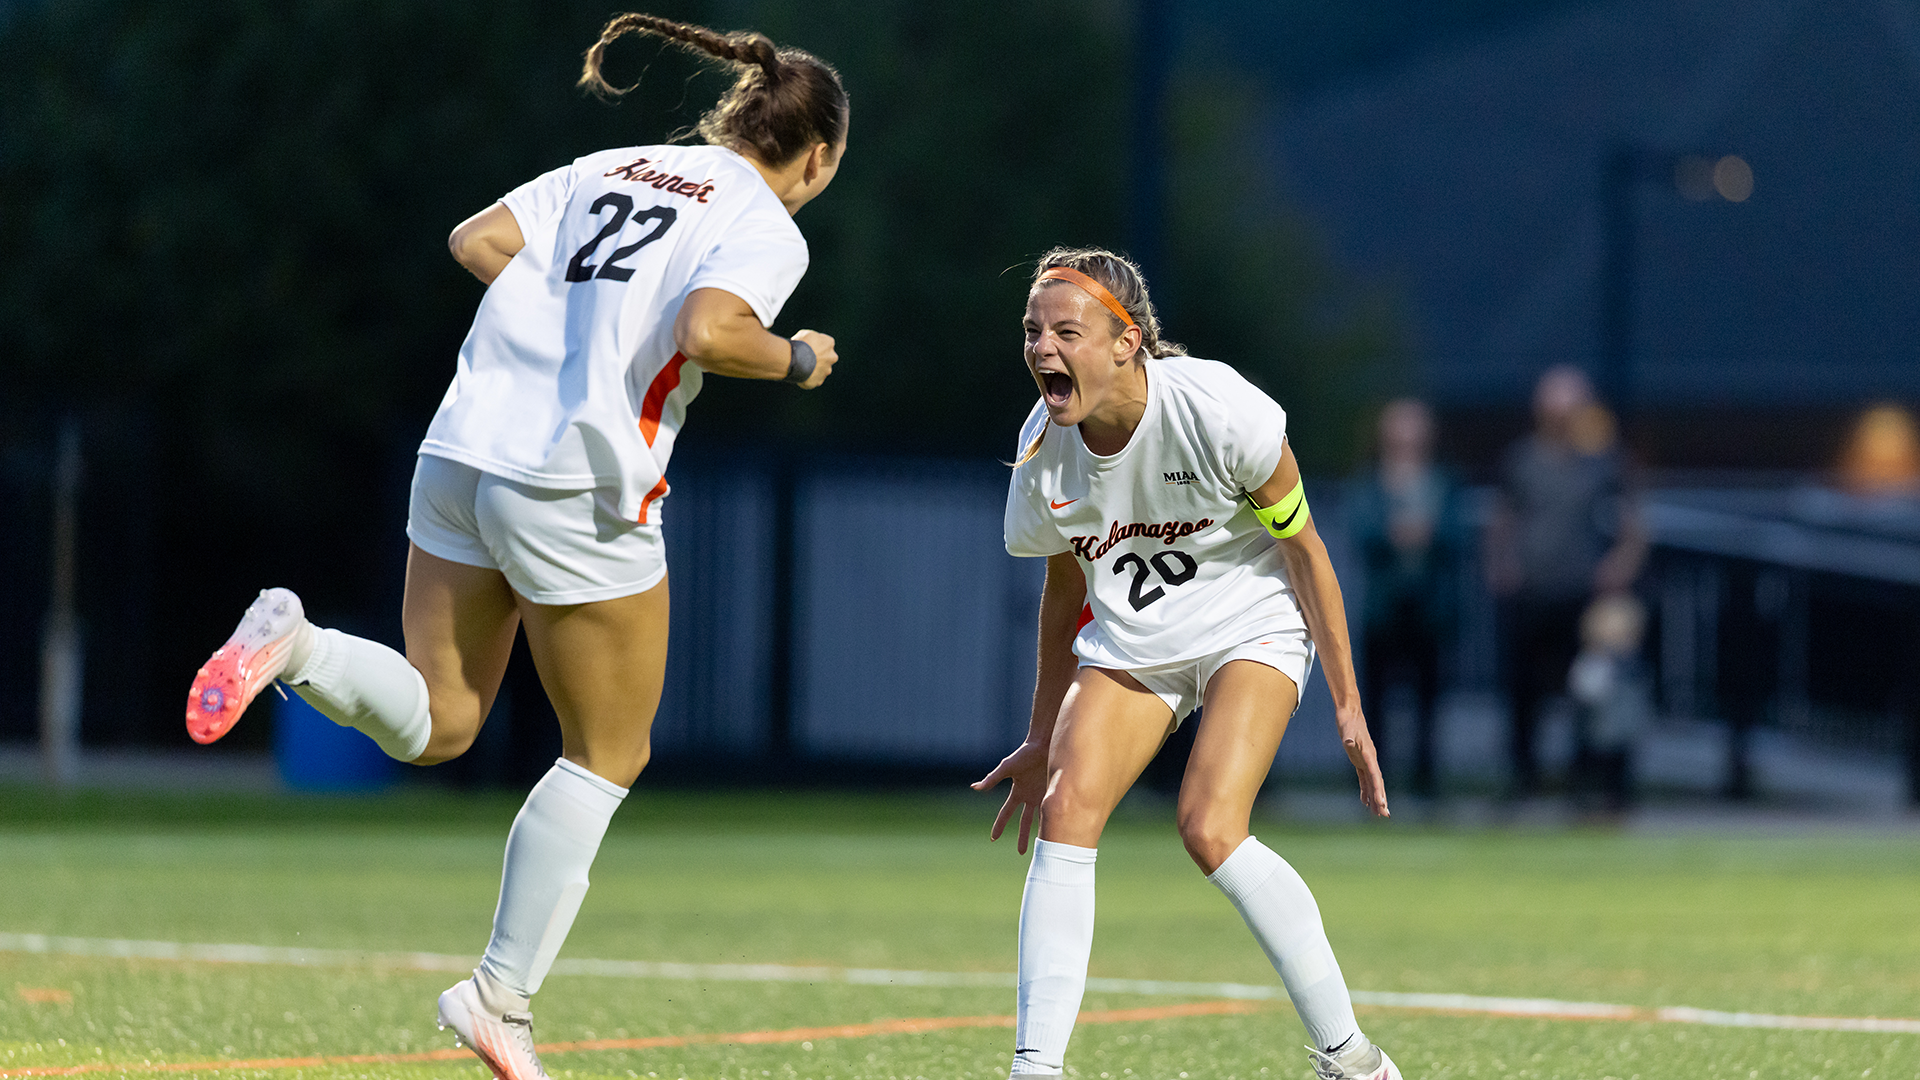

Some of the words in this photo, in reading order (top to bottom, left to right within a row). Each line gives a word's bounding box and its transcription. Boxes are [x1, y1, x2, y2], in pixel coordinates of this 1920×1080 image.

[564, 191, 678, 282] 22
[1162, 470, 1201, 482] MIAA
[1069, 517, 1215, 562] Kalamazoo
[1111, 549, 1198, 612] 20
